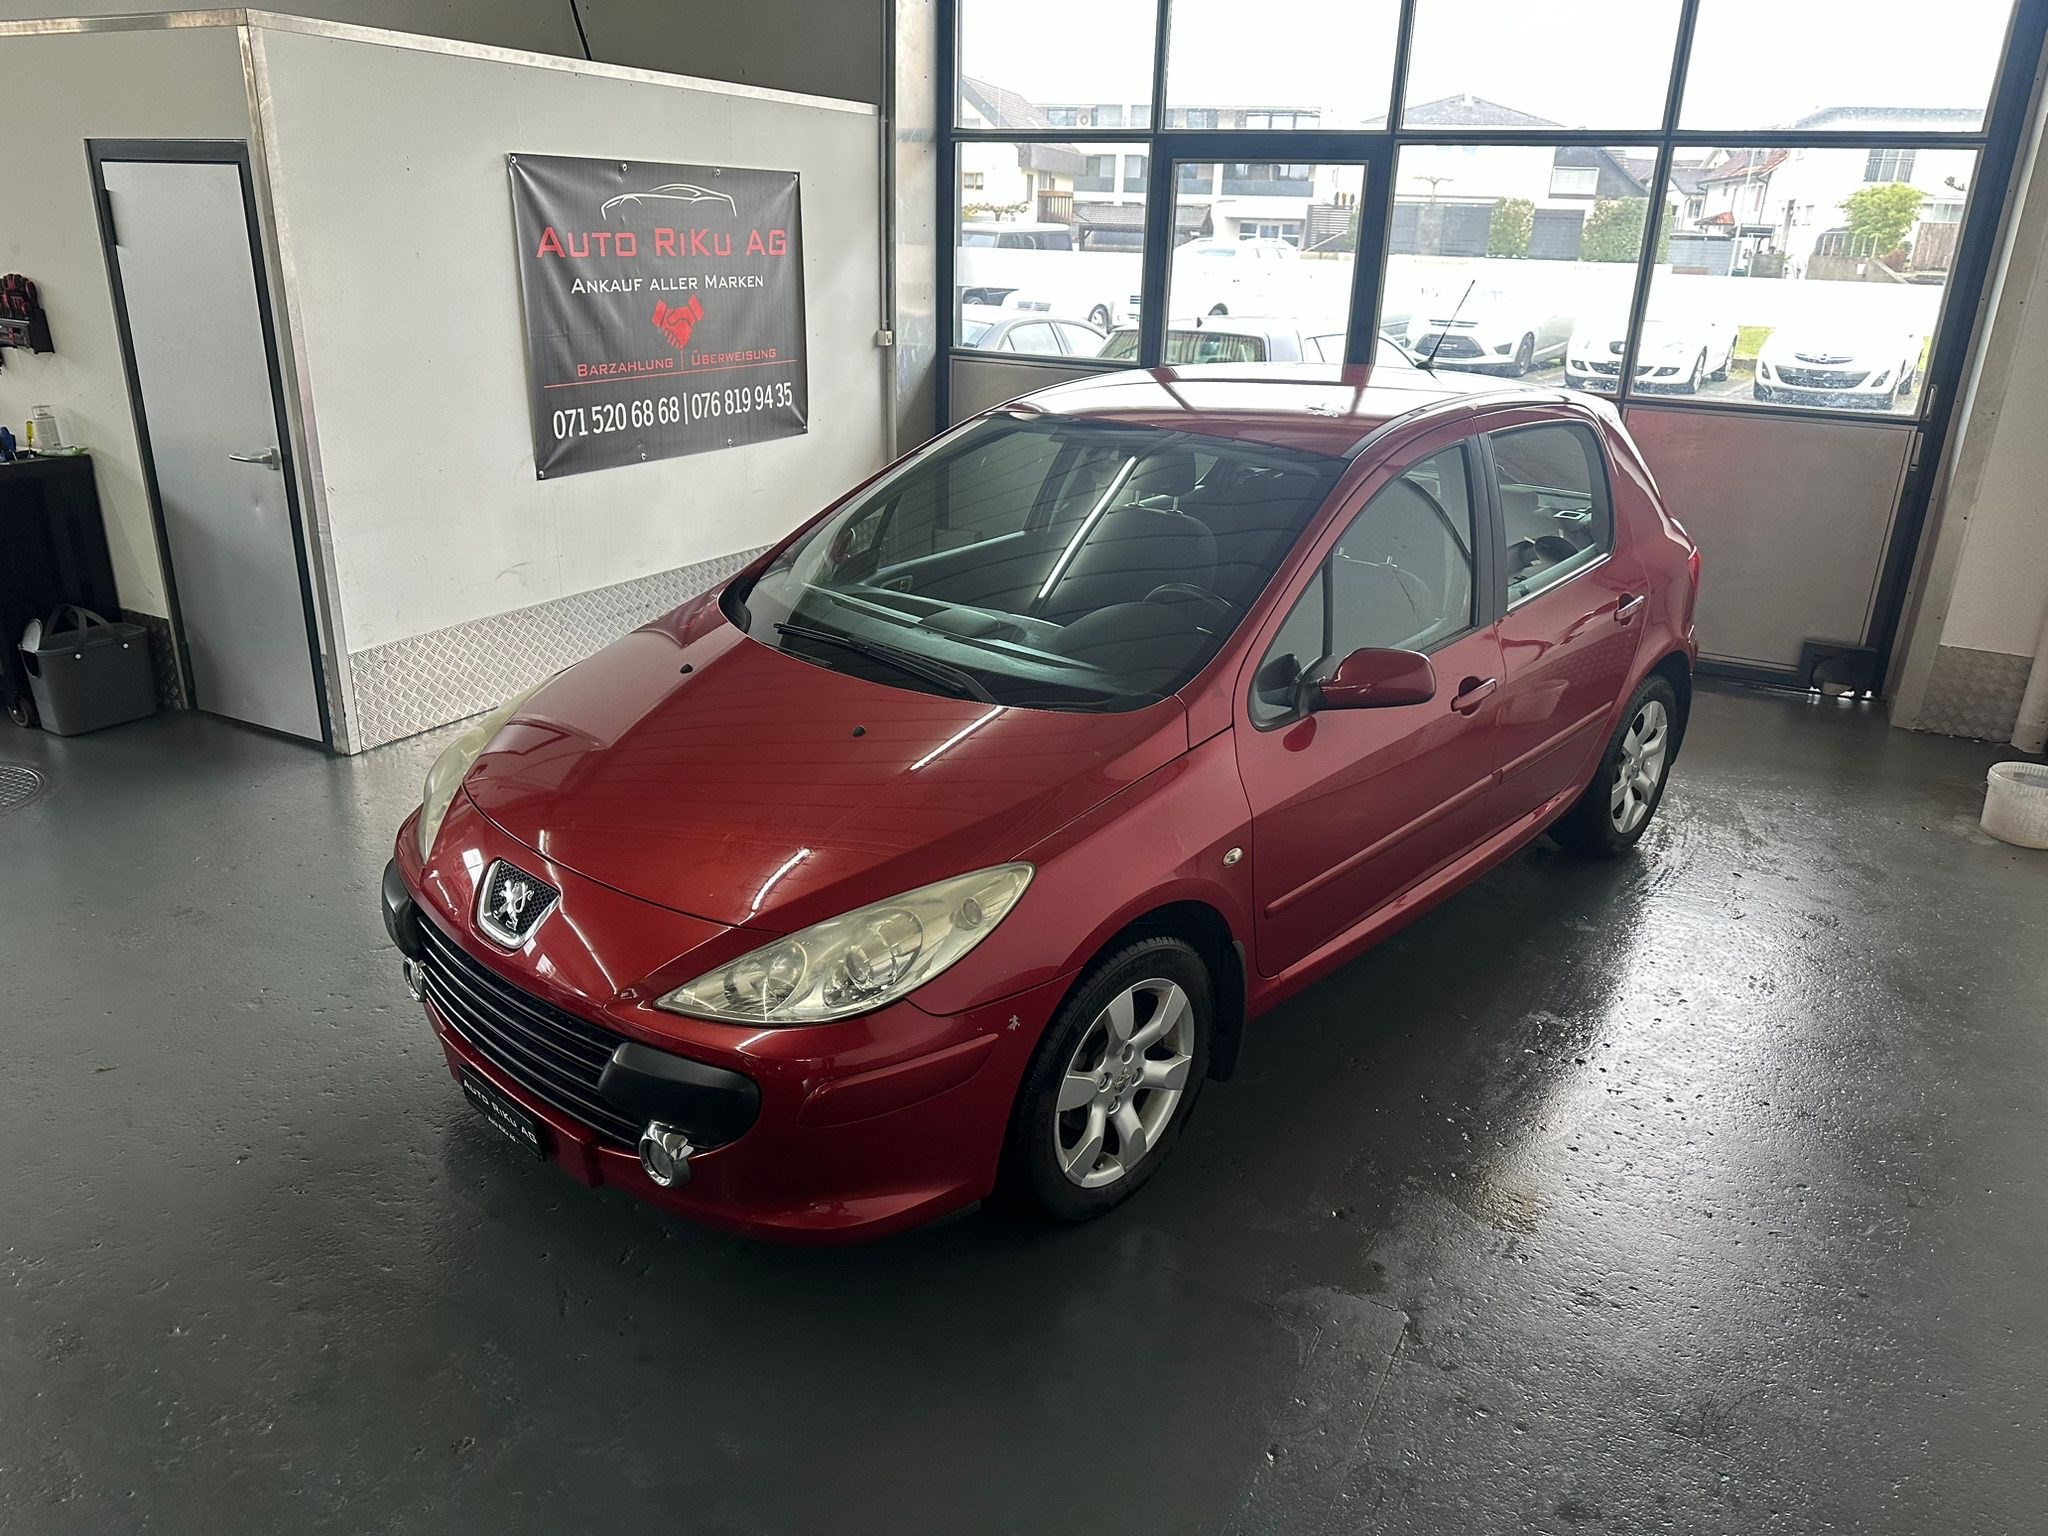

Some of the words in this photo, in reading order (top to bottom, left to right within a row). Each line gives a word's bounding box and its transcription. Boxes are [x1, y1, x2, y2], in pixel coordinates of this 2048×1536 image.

[746, 229, 787, 256] AG
[553, 408, 588, 440] 071
[591, 402, 627, 434] 520
[631, 399, 654, 428] 68
[658, 396, 680, 425] 68
[692, 391, 721, 420] 076
[724, 387, 751, 415] 819
[755, 384, 773, 411] 94
[776, 382, 793, 408] 35
